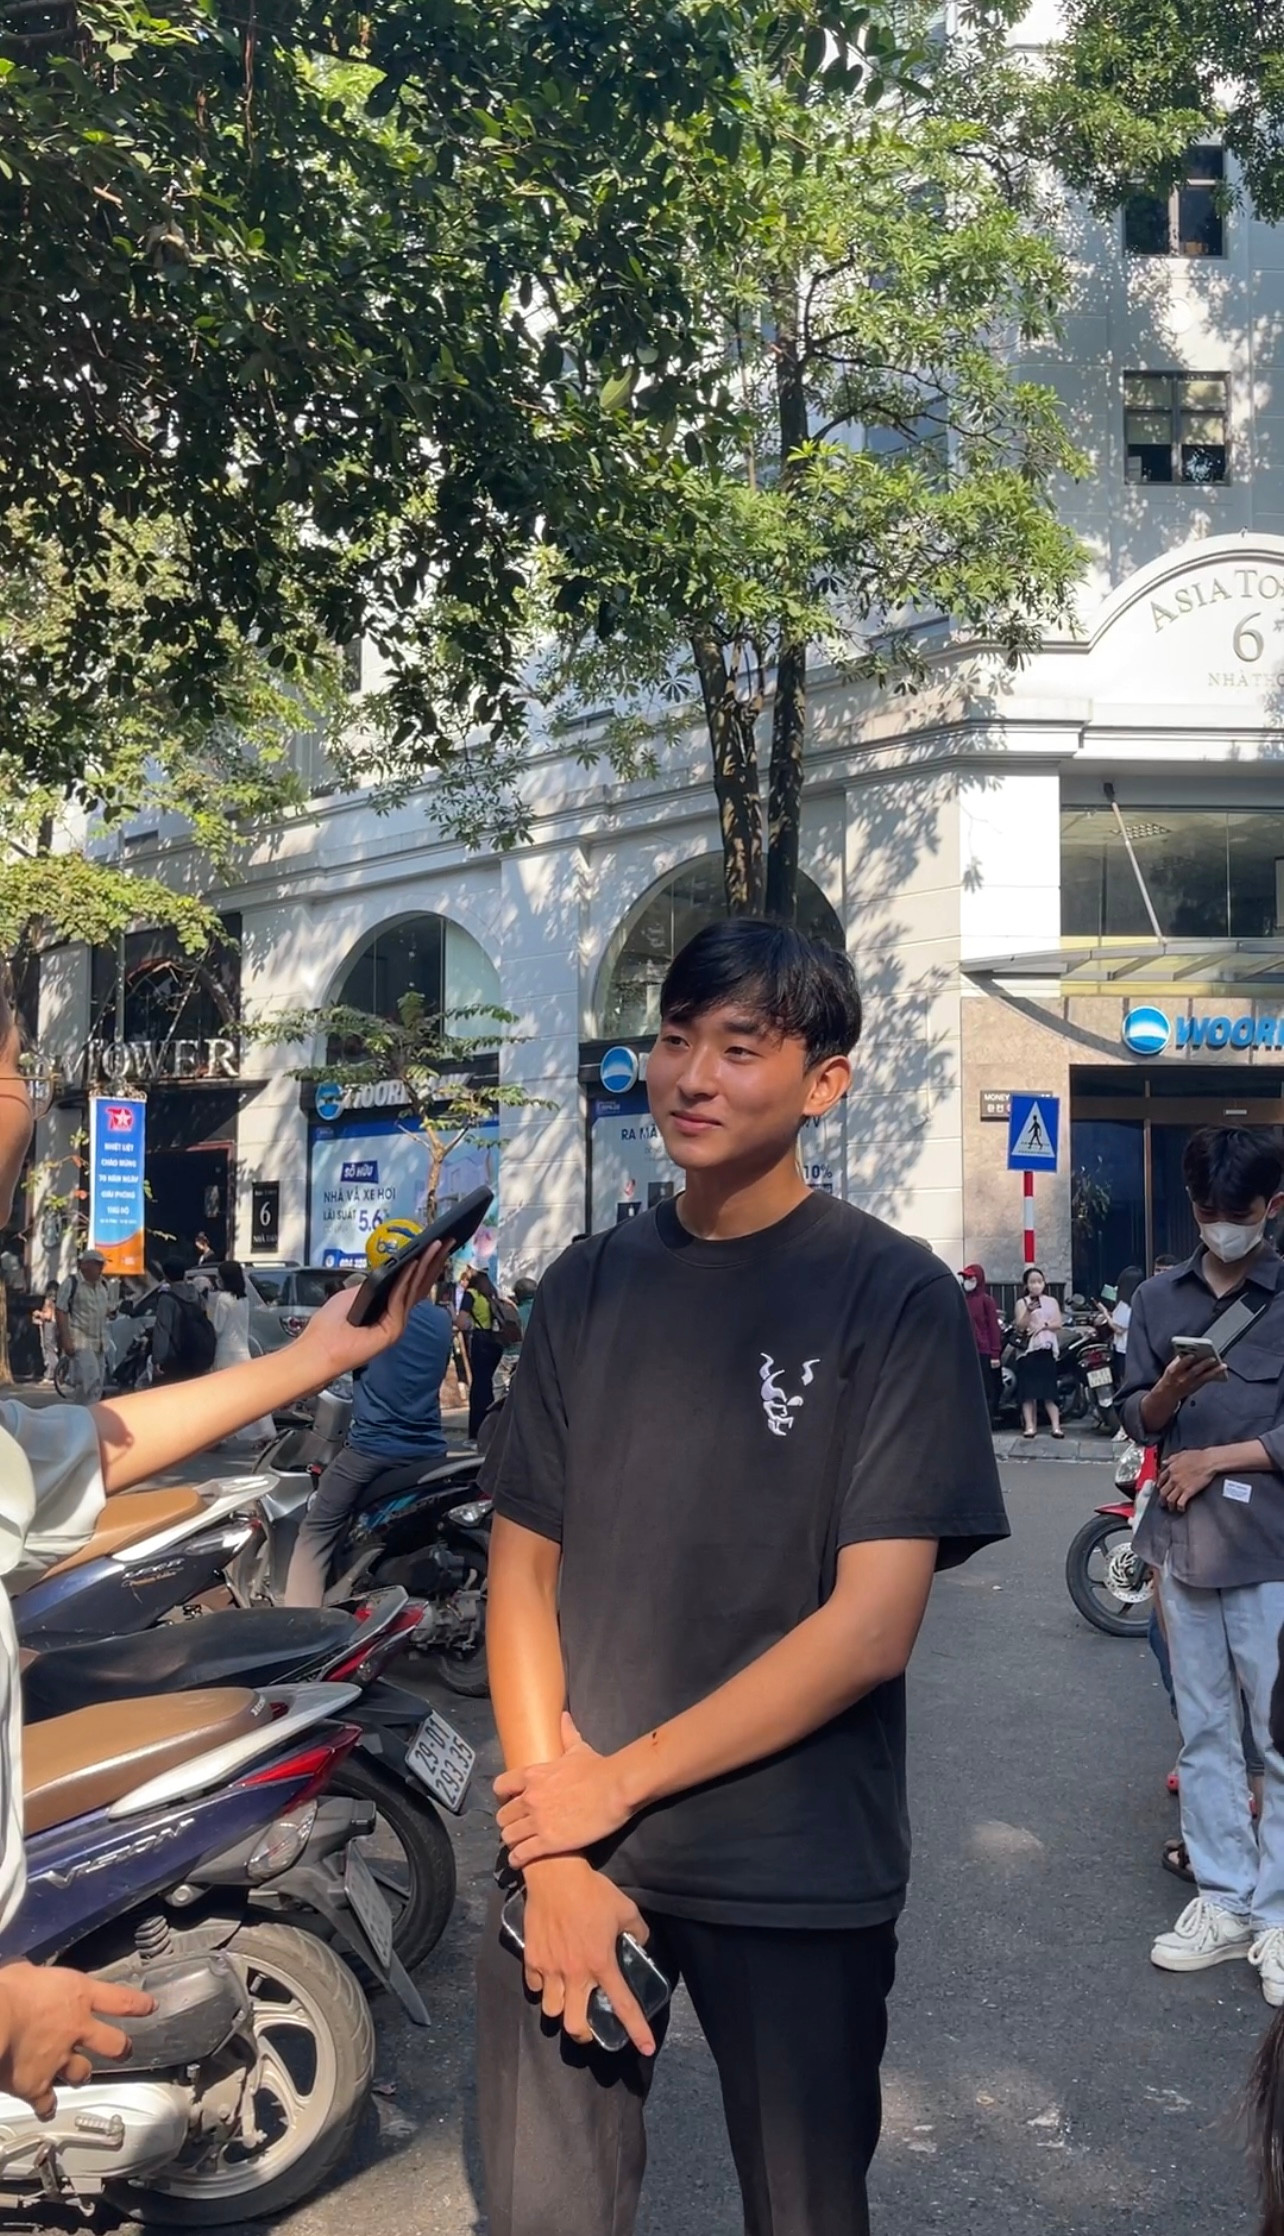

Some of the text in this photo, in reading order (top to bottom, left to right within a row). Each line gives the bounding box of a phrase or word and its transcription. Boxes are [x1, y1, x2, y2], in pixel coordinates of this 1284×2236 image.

[1150, 569, 1284, 634] ASIA TO
[1232, 611, 1265, 663] 6
[1208, 669, 1248, 687] NHÀ
[621, 1128, 637, 1140] RA
[804, 1164, 833, 1179] 10%
[323, 1187, 344, 1203] NHÀ
[363, 1188, 375, 1201] XE
[260, 1201, 271, 1227] 6
[435, 1736, 473, 1805] 293.35
